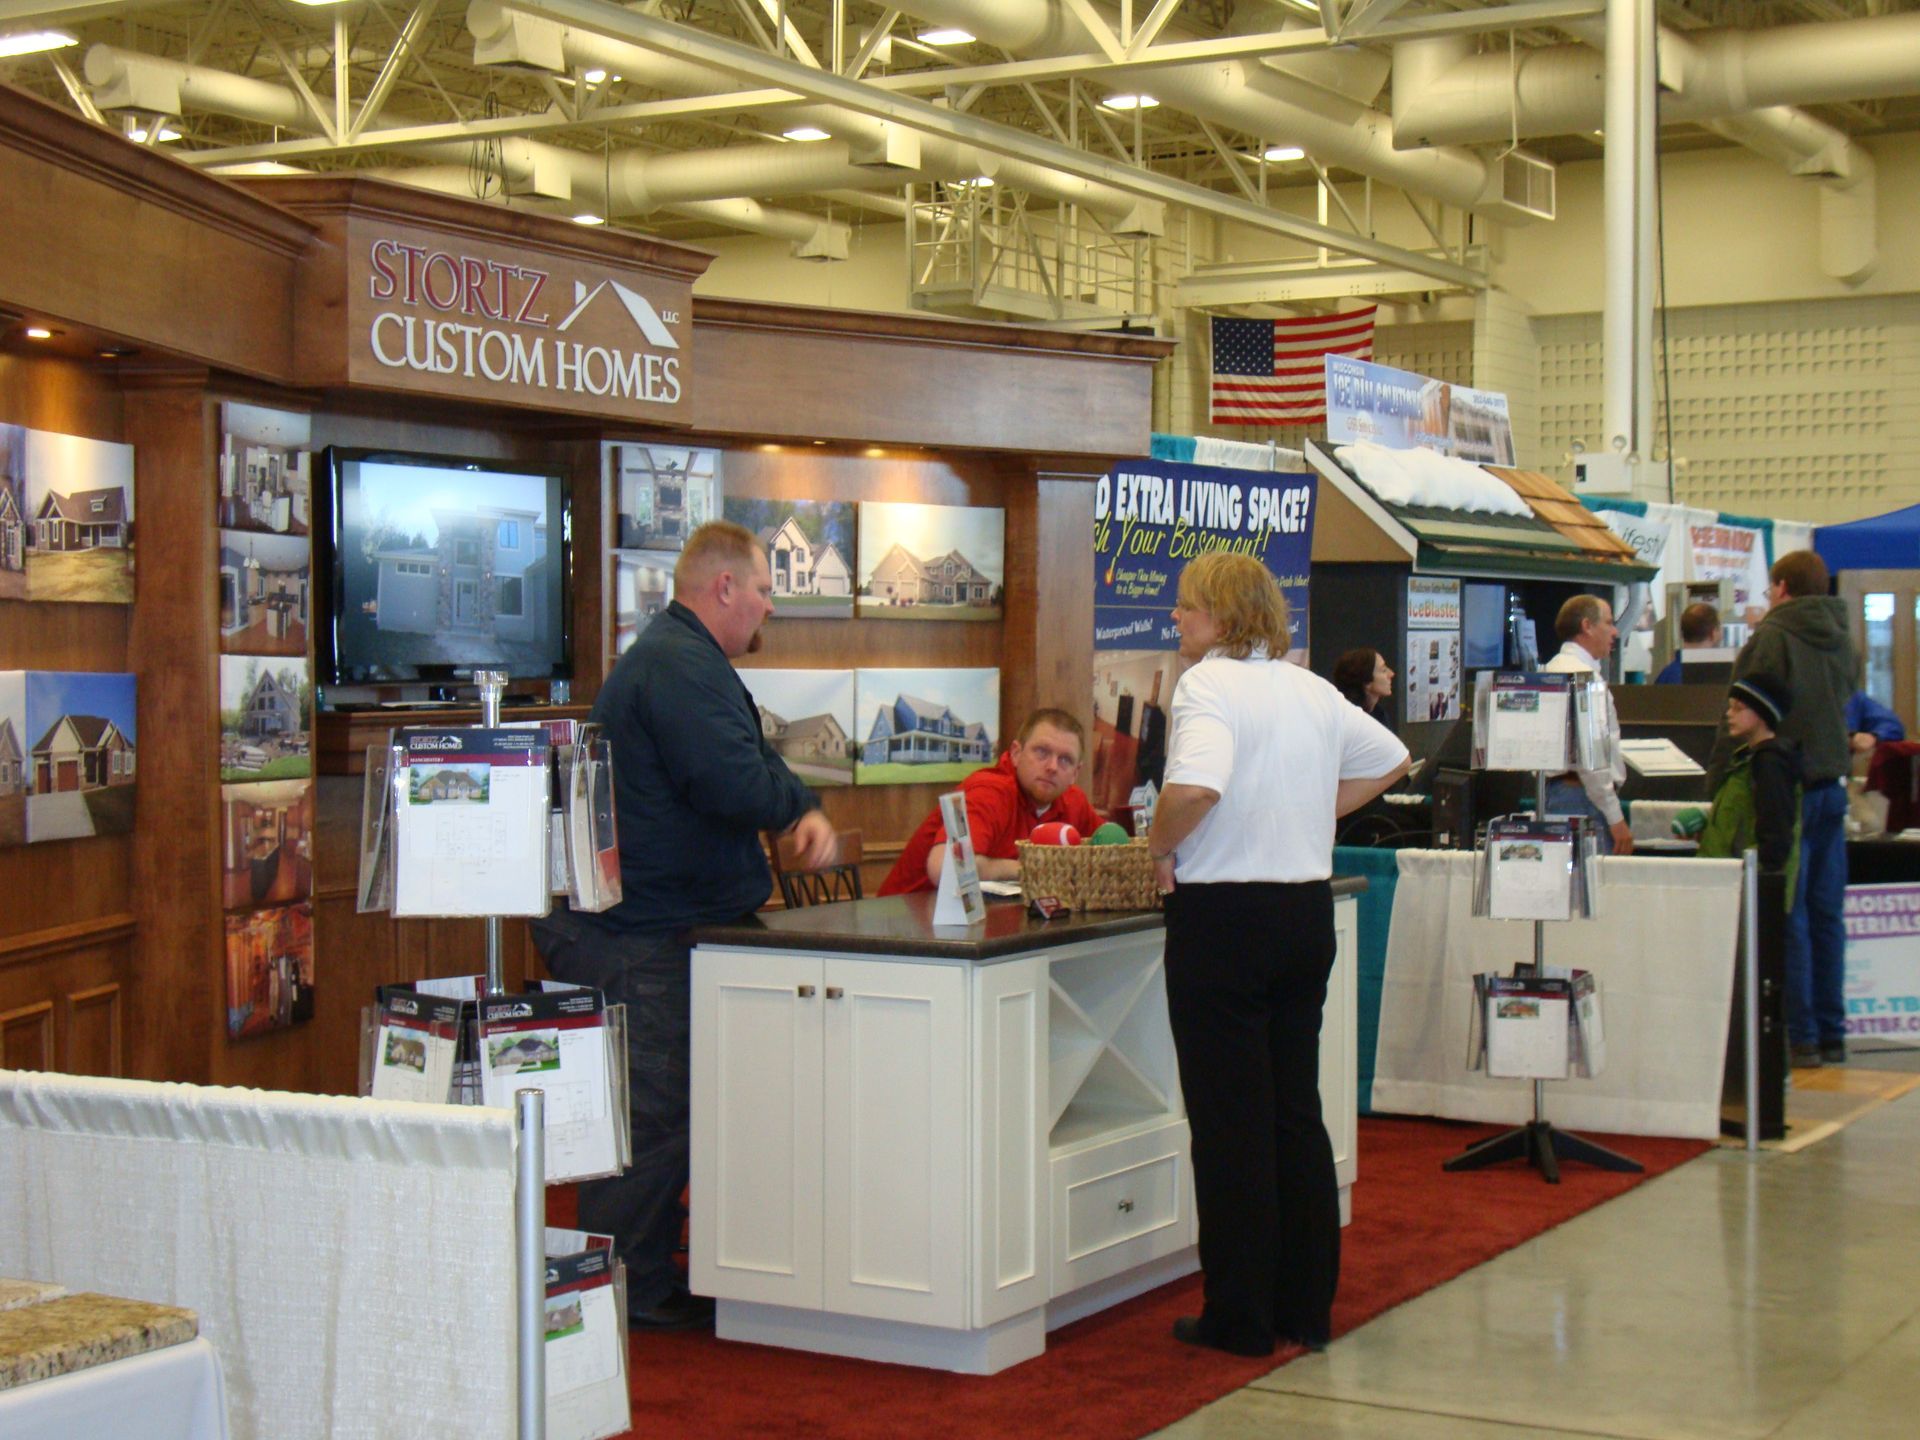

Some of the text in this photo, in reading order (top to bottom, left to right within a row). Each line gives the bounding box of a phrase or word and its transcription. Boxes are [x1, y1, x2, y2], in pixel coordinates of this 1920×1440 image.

[371, 240, 549, 327] STORTZ
[662, 310, 680, 324] LLC
[370, 313, 681, 403] CUSTOM HOMES
[1115, 473, 1175, 526] EXTRA
[1179, 479, 1243, 531] LIVING
[1248, 485, 1310, 533] SPACE?
[1116, 513, 1166, 558] Your
[1169, 517, 1273, 562] Basement!
[1096, 622, 1134, 640] Waterproof
[1134, 618, 1153, 634] Walls!
